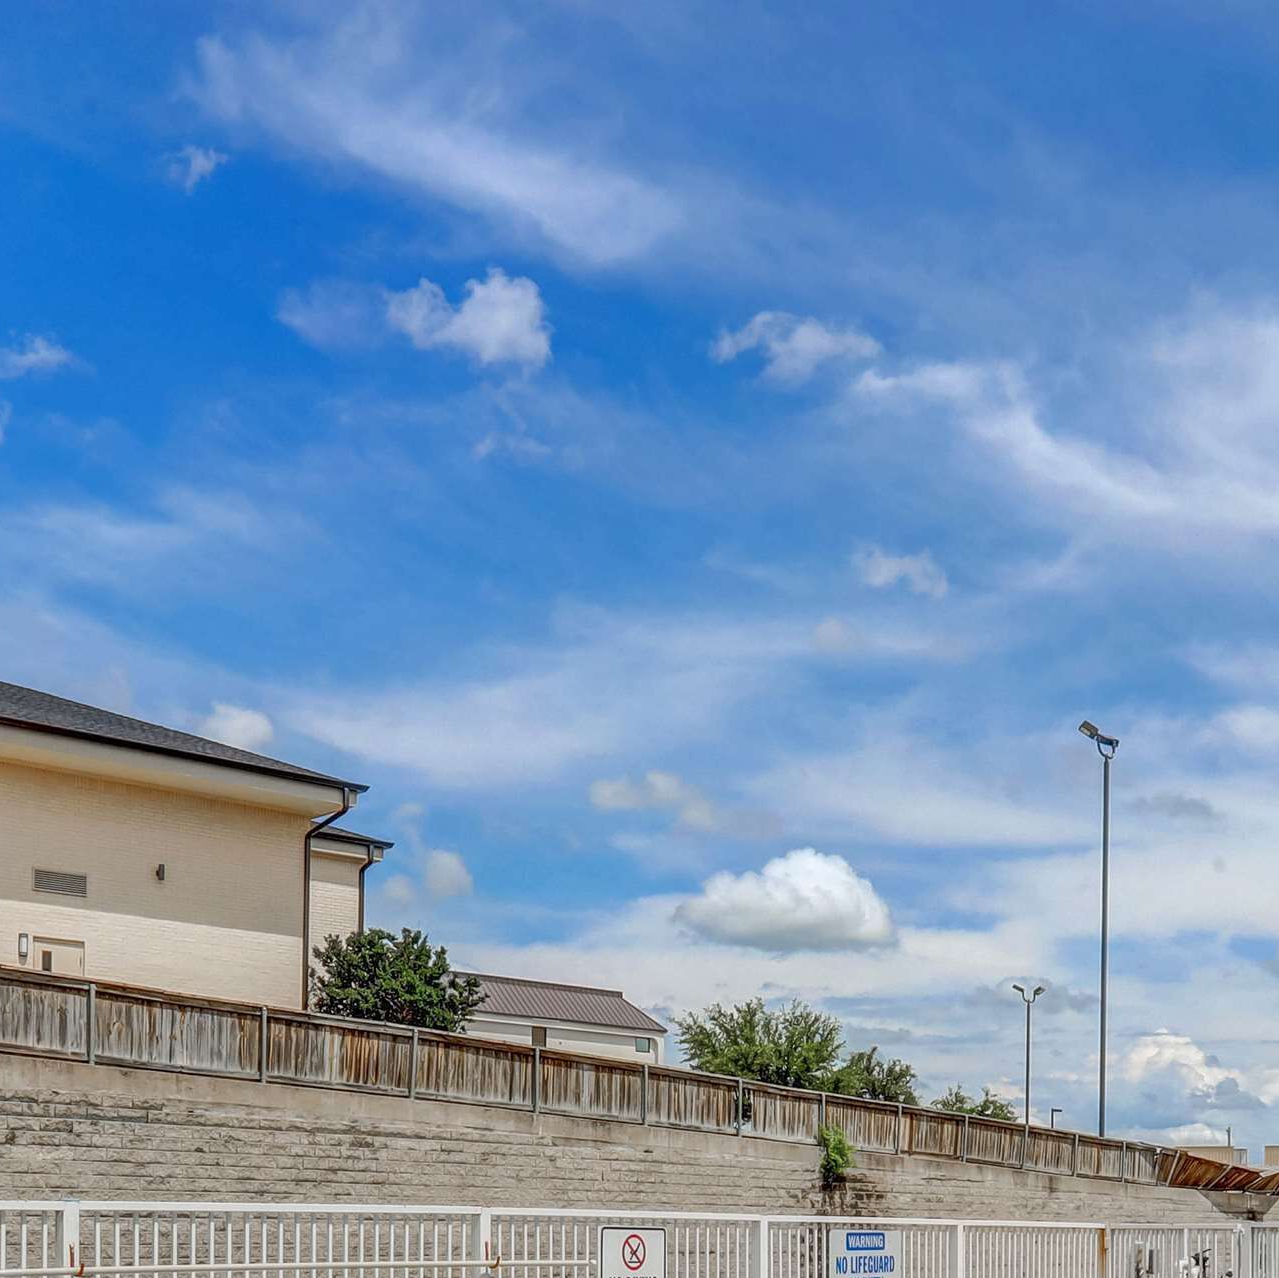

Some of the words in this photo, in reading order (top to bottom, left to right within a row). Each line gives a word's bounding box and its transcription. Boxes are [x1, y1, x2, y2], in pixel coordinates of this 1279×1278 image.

[848, 1235, 884, 1248] WARNING
[836, 1256, 848, 1274] NO
[851, 1255, 895, 1274] LIFEGUARD
